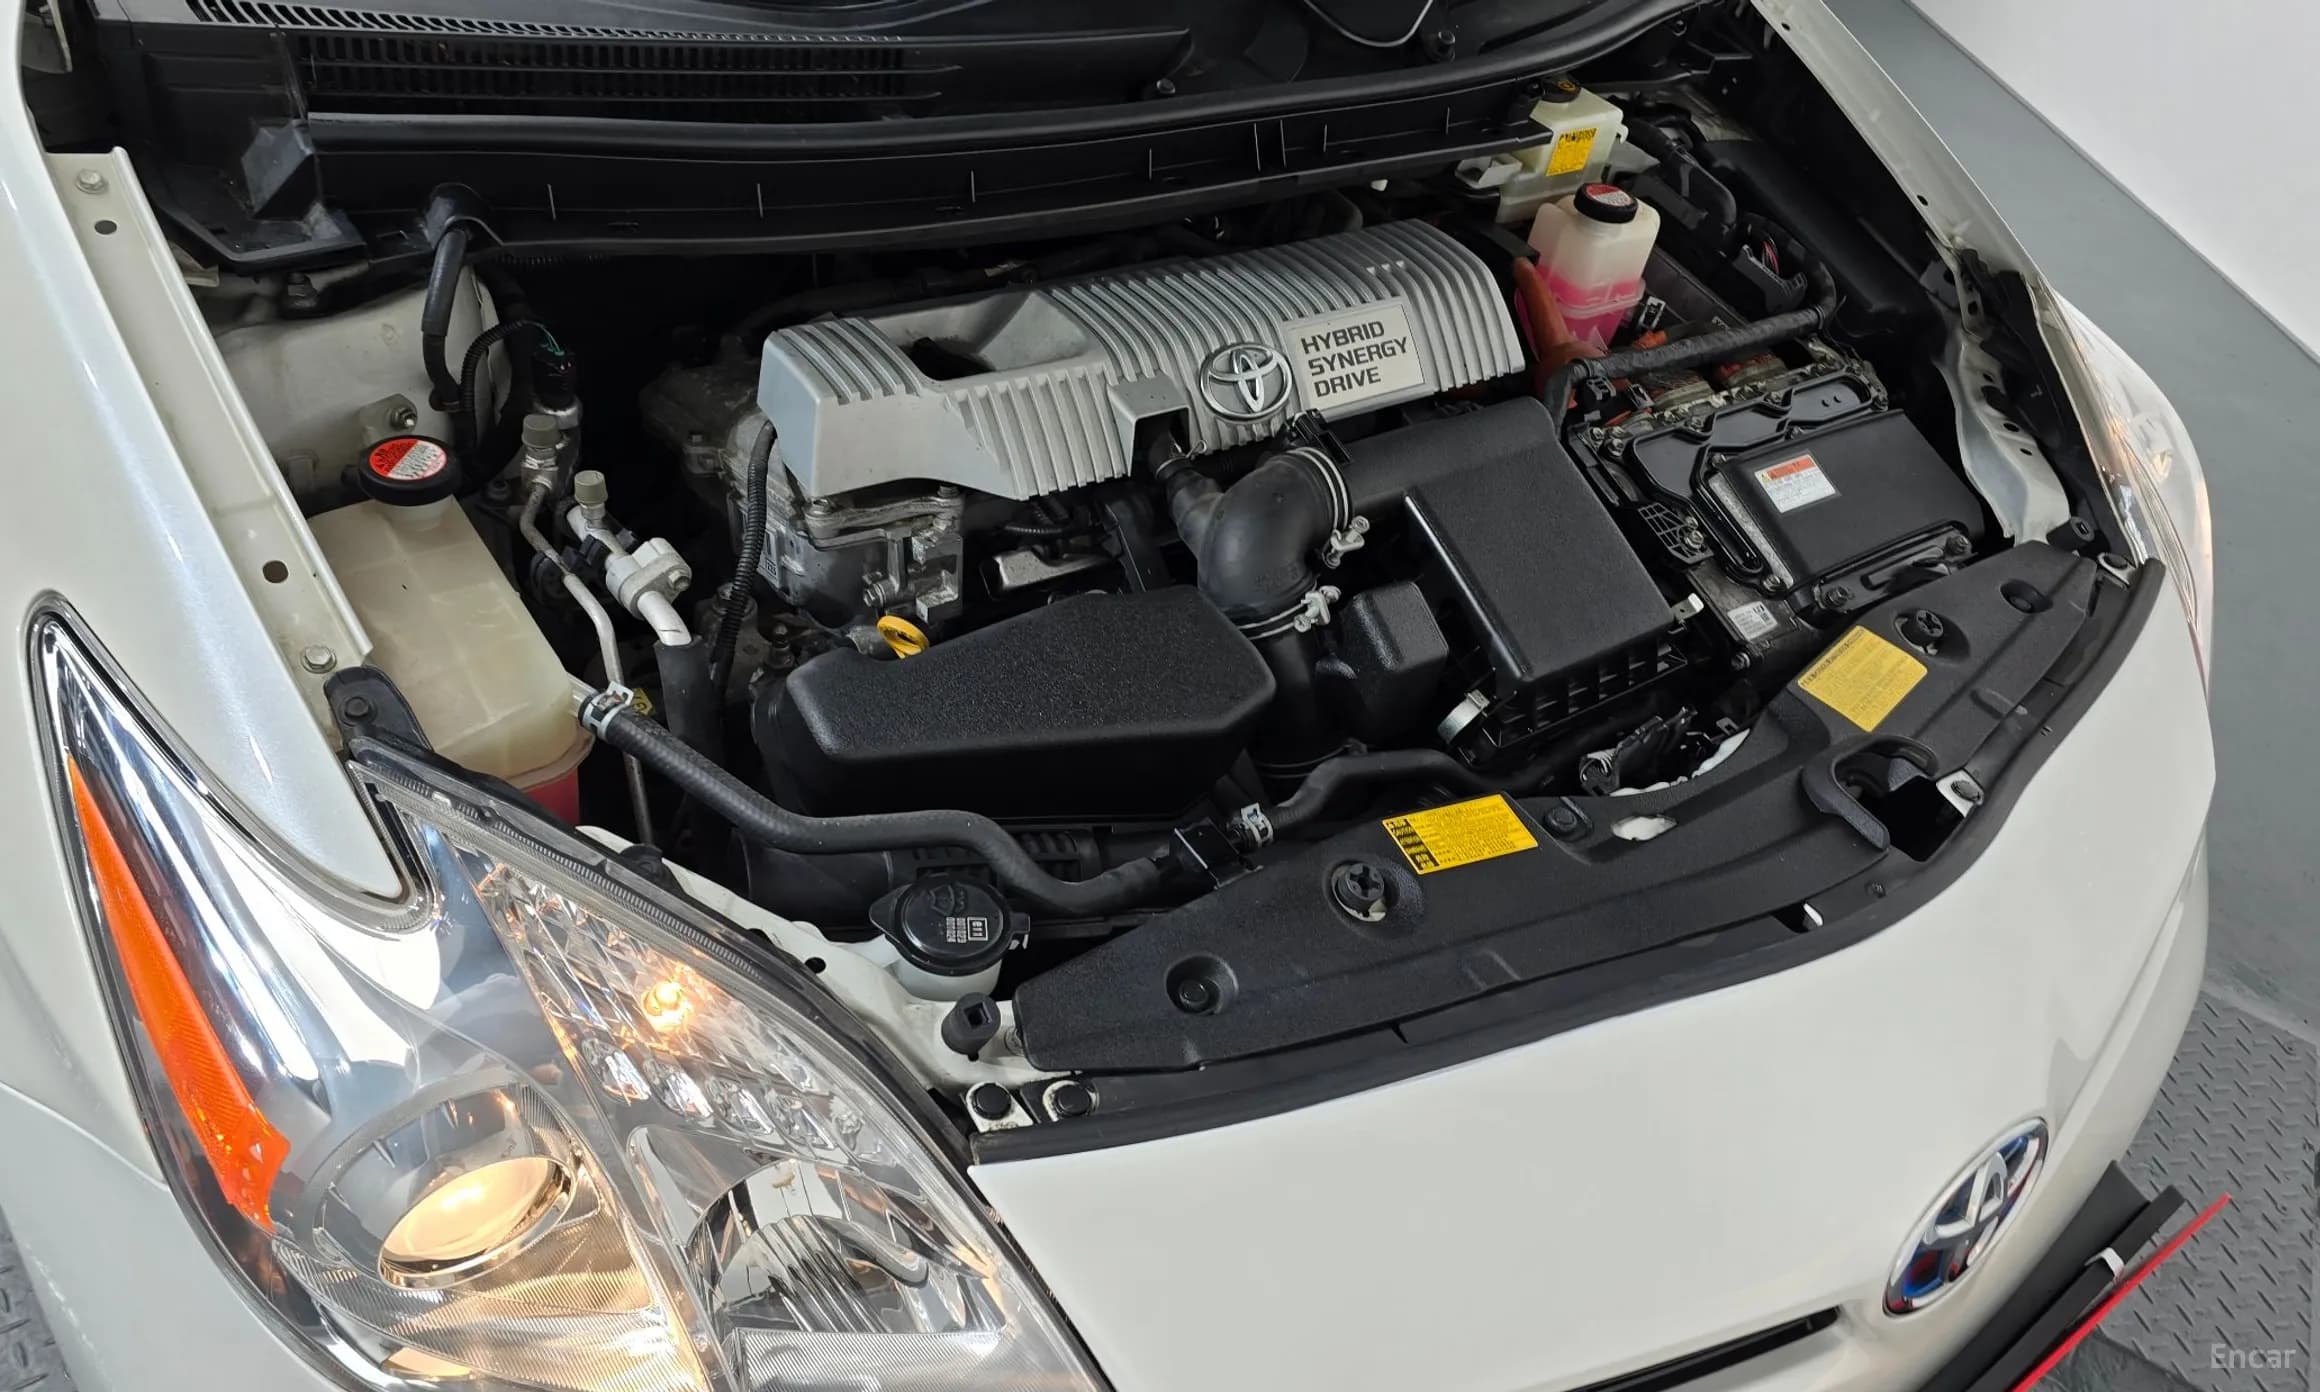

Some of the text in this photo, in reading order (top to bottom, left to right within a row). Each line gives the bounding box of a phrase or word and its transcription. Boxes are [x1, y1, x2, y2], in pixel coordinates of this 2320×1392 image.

[1301, 321, 1384, 354] HYBRID
[1308, 336, 1407, 376] SYNERGY
[1314, 366, 1381, 397] DRIVE
